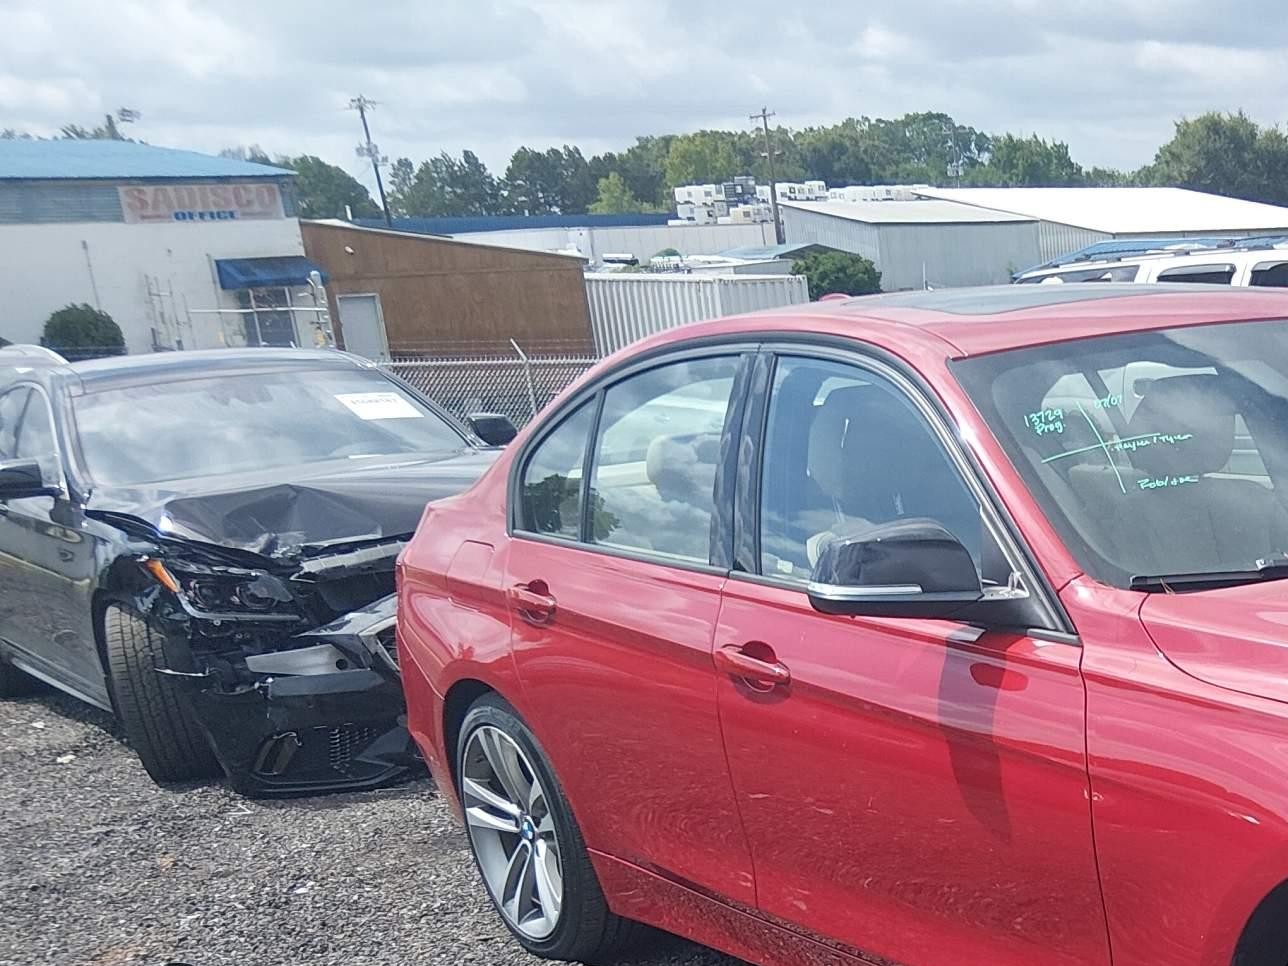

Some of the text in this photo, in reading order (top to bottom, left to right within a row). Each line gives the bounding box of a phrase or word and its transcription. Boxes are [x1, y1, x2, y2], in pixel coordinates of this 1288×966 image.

[126, 185, 277, 210] SADISCO
[173, 210, 237, 221] OFFICE
[1024, 408, 1064, 427] 13729
